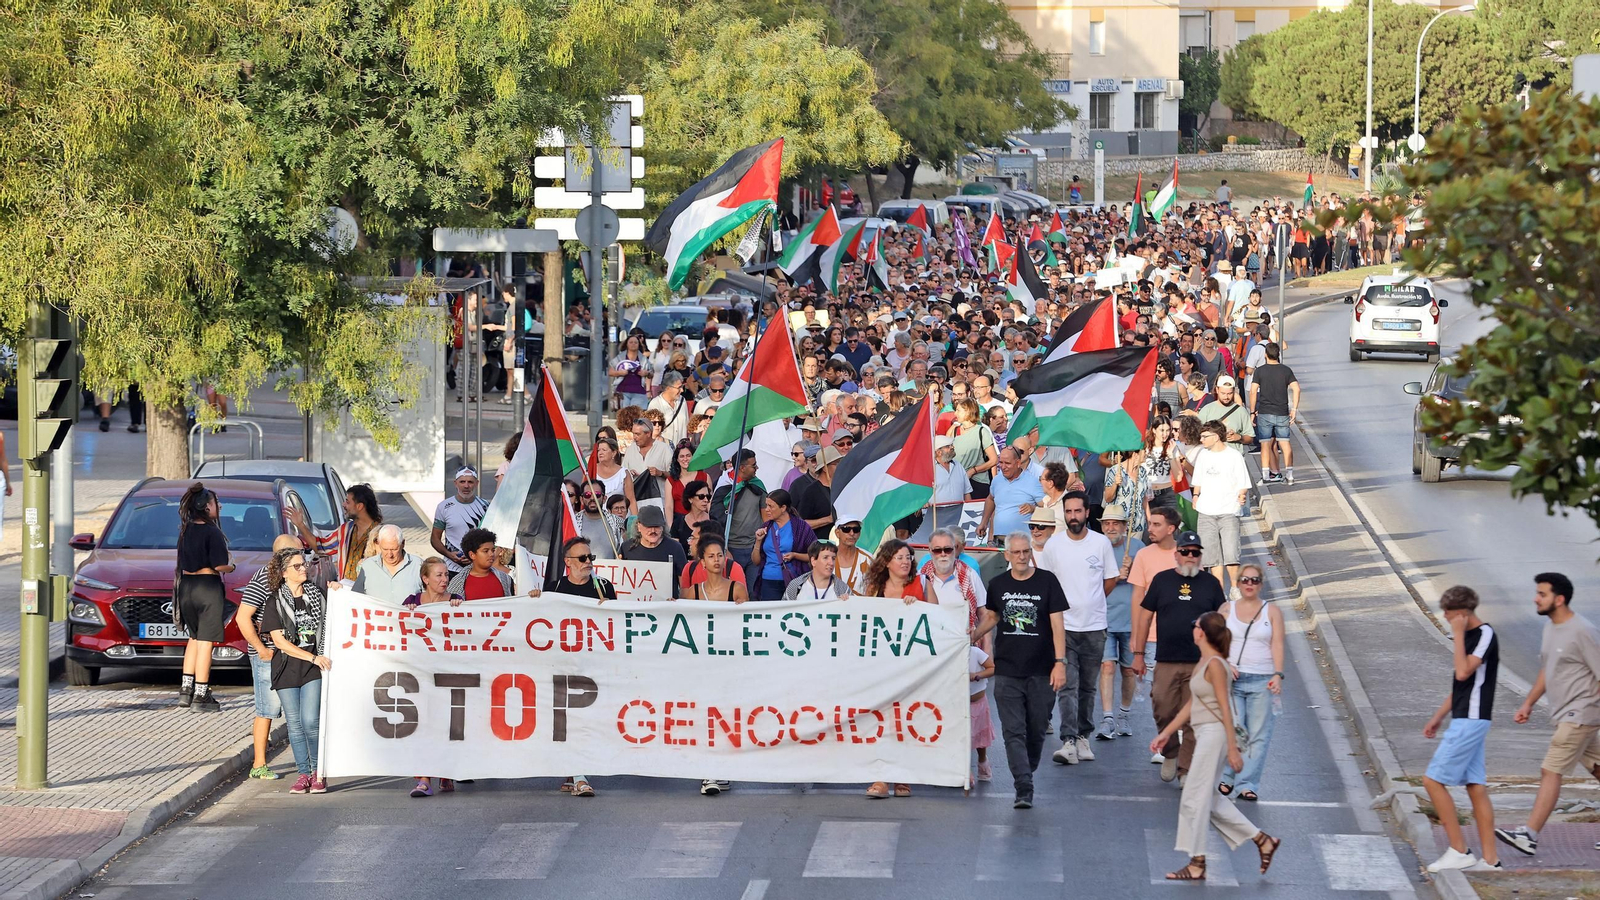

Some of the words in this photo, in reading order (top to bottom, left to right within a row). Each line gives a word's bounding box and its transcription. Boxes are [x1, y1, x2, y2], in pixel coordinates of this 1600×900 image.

[1138, 79, 1164, 90] ARENAL
[148, 625, 178, 637] 6813
[342, 607, 516, 653] JEREZ
[525, 617, 615, 653] CON
[625, 611, 937, 658] PALESTINA
[372, 671, 599, 742] STOP
[616, 698, 943, 749] GENOCIDIO
